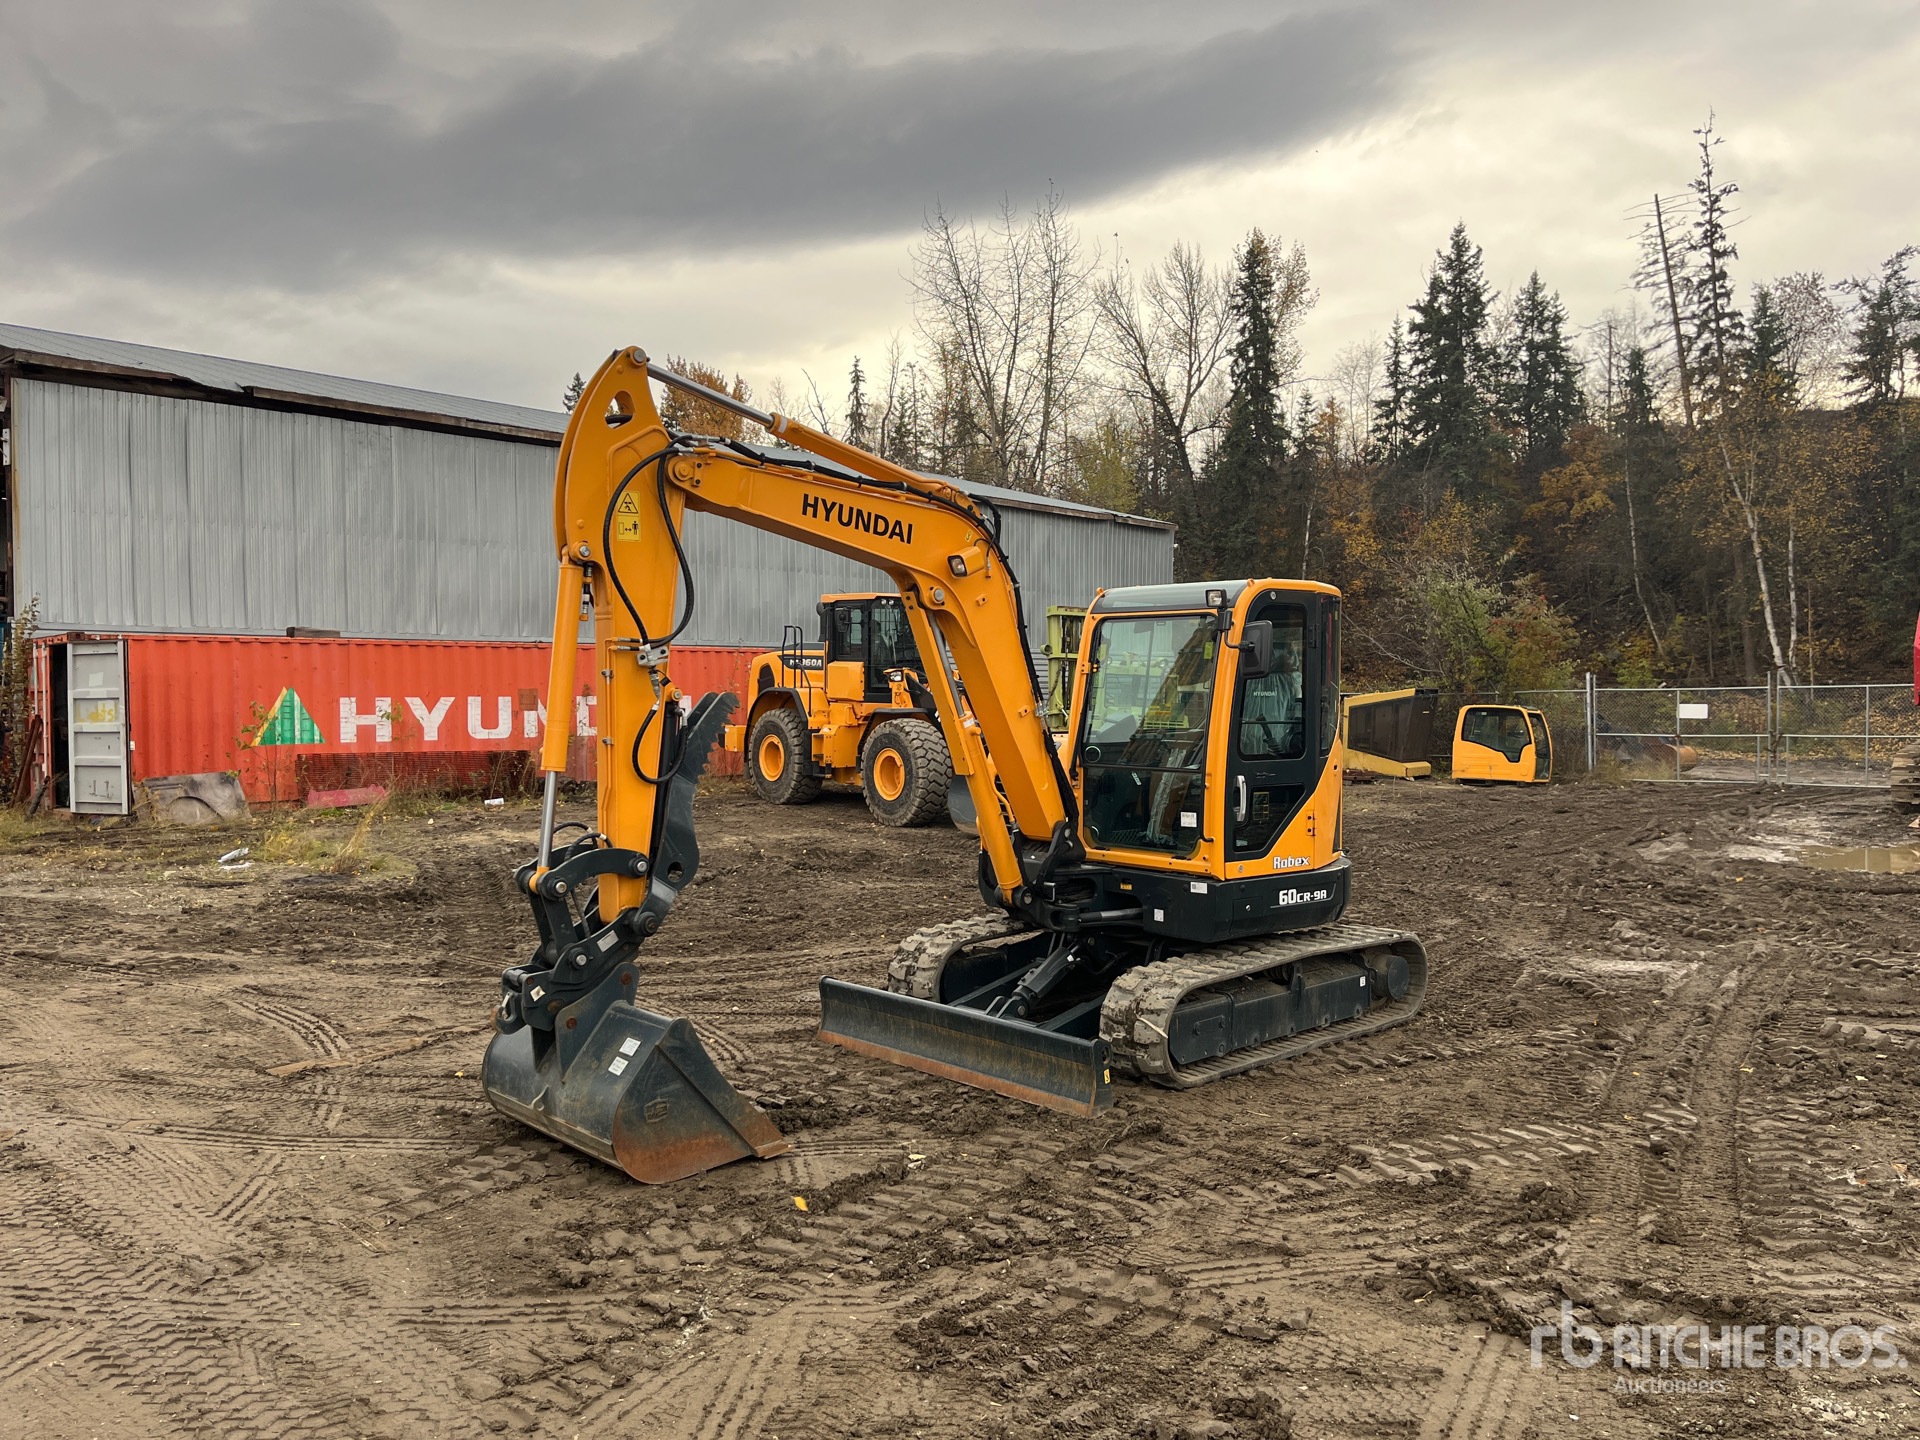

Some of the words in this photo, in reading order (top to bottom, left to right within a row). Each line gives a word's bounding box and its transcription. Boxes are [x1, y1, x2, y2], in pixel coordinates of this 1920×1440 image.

[802, 493, 913, 544] HYUNDAI
[1273, 856, 1310, 869] Robex
[1279, 889, 1327, 905] 60CR-9A
